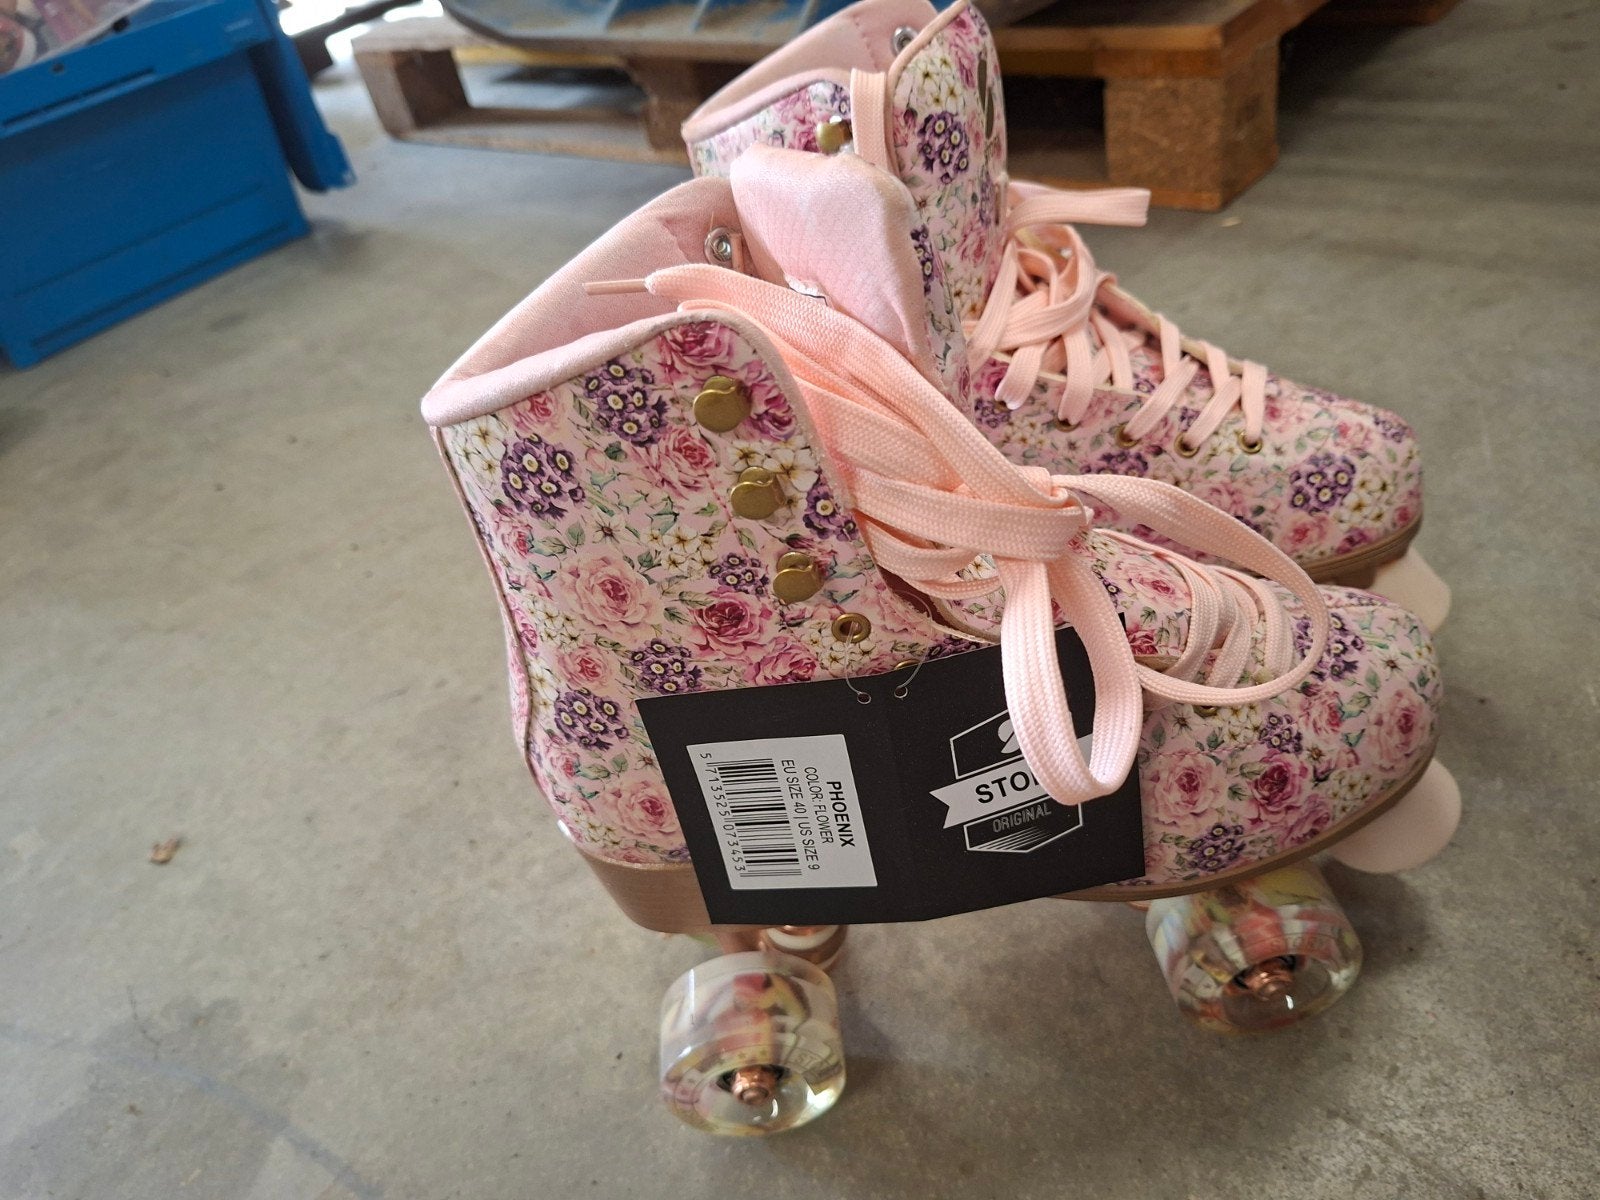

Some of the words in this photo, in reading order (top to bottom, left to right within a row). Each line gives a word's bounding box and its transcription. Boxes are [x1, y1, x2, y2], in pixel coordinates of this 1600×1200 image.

[781, 759, 797, 775] EU
[786, 777, 804, 799] SIZE
[804, 766, 824, 803] COLOR:
[975, 770, 1040, 804] STO
[704, 767, 731, 818] 713525
[723, 823, 747, 872] 073453
[793, 801, 807, 814] 40
[826, 781, 856, 848] PHOENIX
[992, 802, 1052, 833] ORIGINAL
[798, 822, 813, 836] US
[813, 804, 834, 844] FLOWER
[802, 839, 819, 862] SIZE
